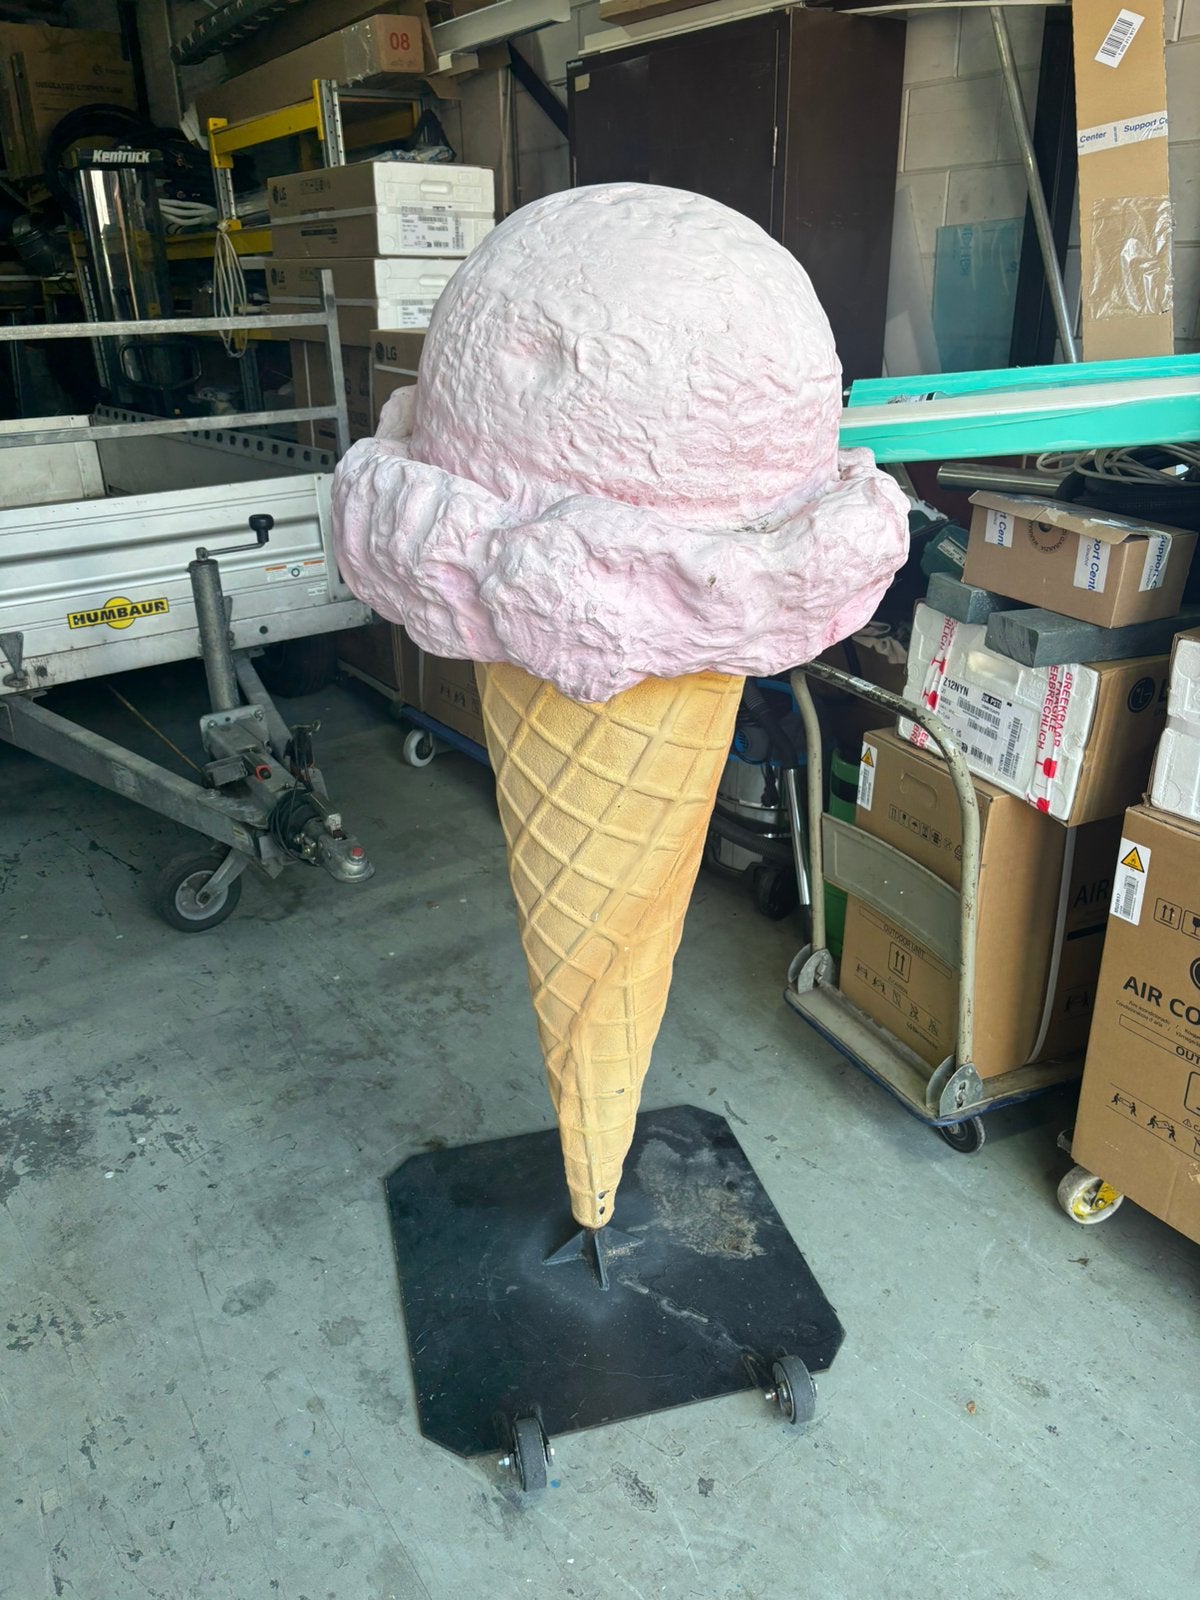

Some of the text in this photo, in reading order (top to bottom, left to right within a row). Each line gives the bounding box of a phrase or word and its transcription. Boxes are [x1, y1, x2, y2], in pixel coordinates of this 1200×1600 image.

[389, 32, 411, 51] 08
[1080, 131, 1107, 143] Center
[1123, 119, 1157, 133] Support
[92, 149, 150, 163] Kentruck
[385, 344, 397, 361] LG
[1088, 562, 1099, 591] Cent
[72, 601, 166, 626] HUMBAUR
[1037, 665, 1058, 750] ERBRECHLICH
[1054, 672, 1073, 748] BREEKBAAR
[1122, 975, 1163, 1008] AIR
